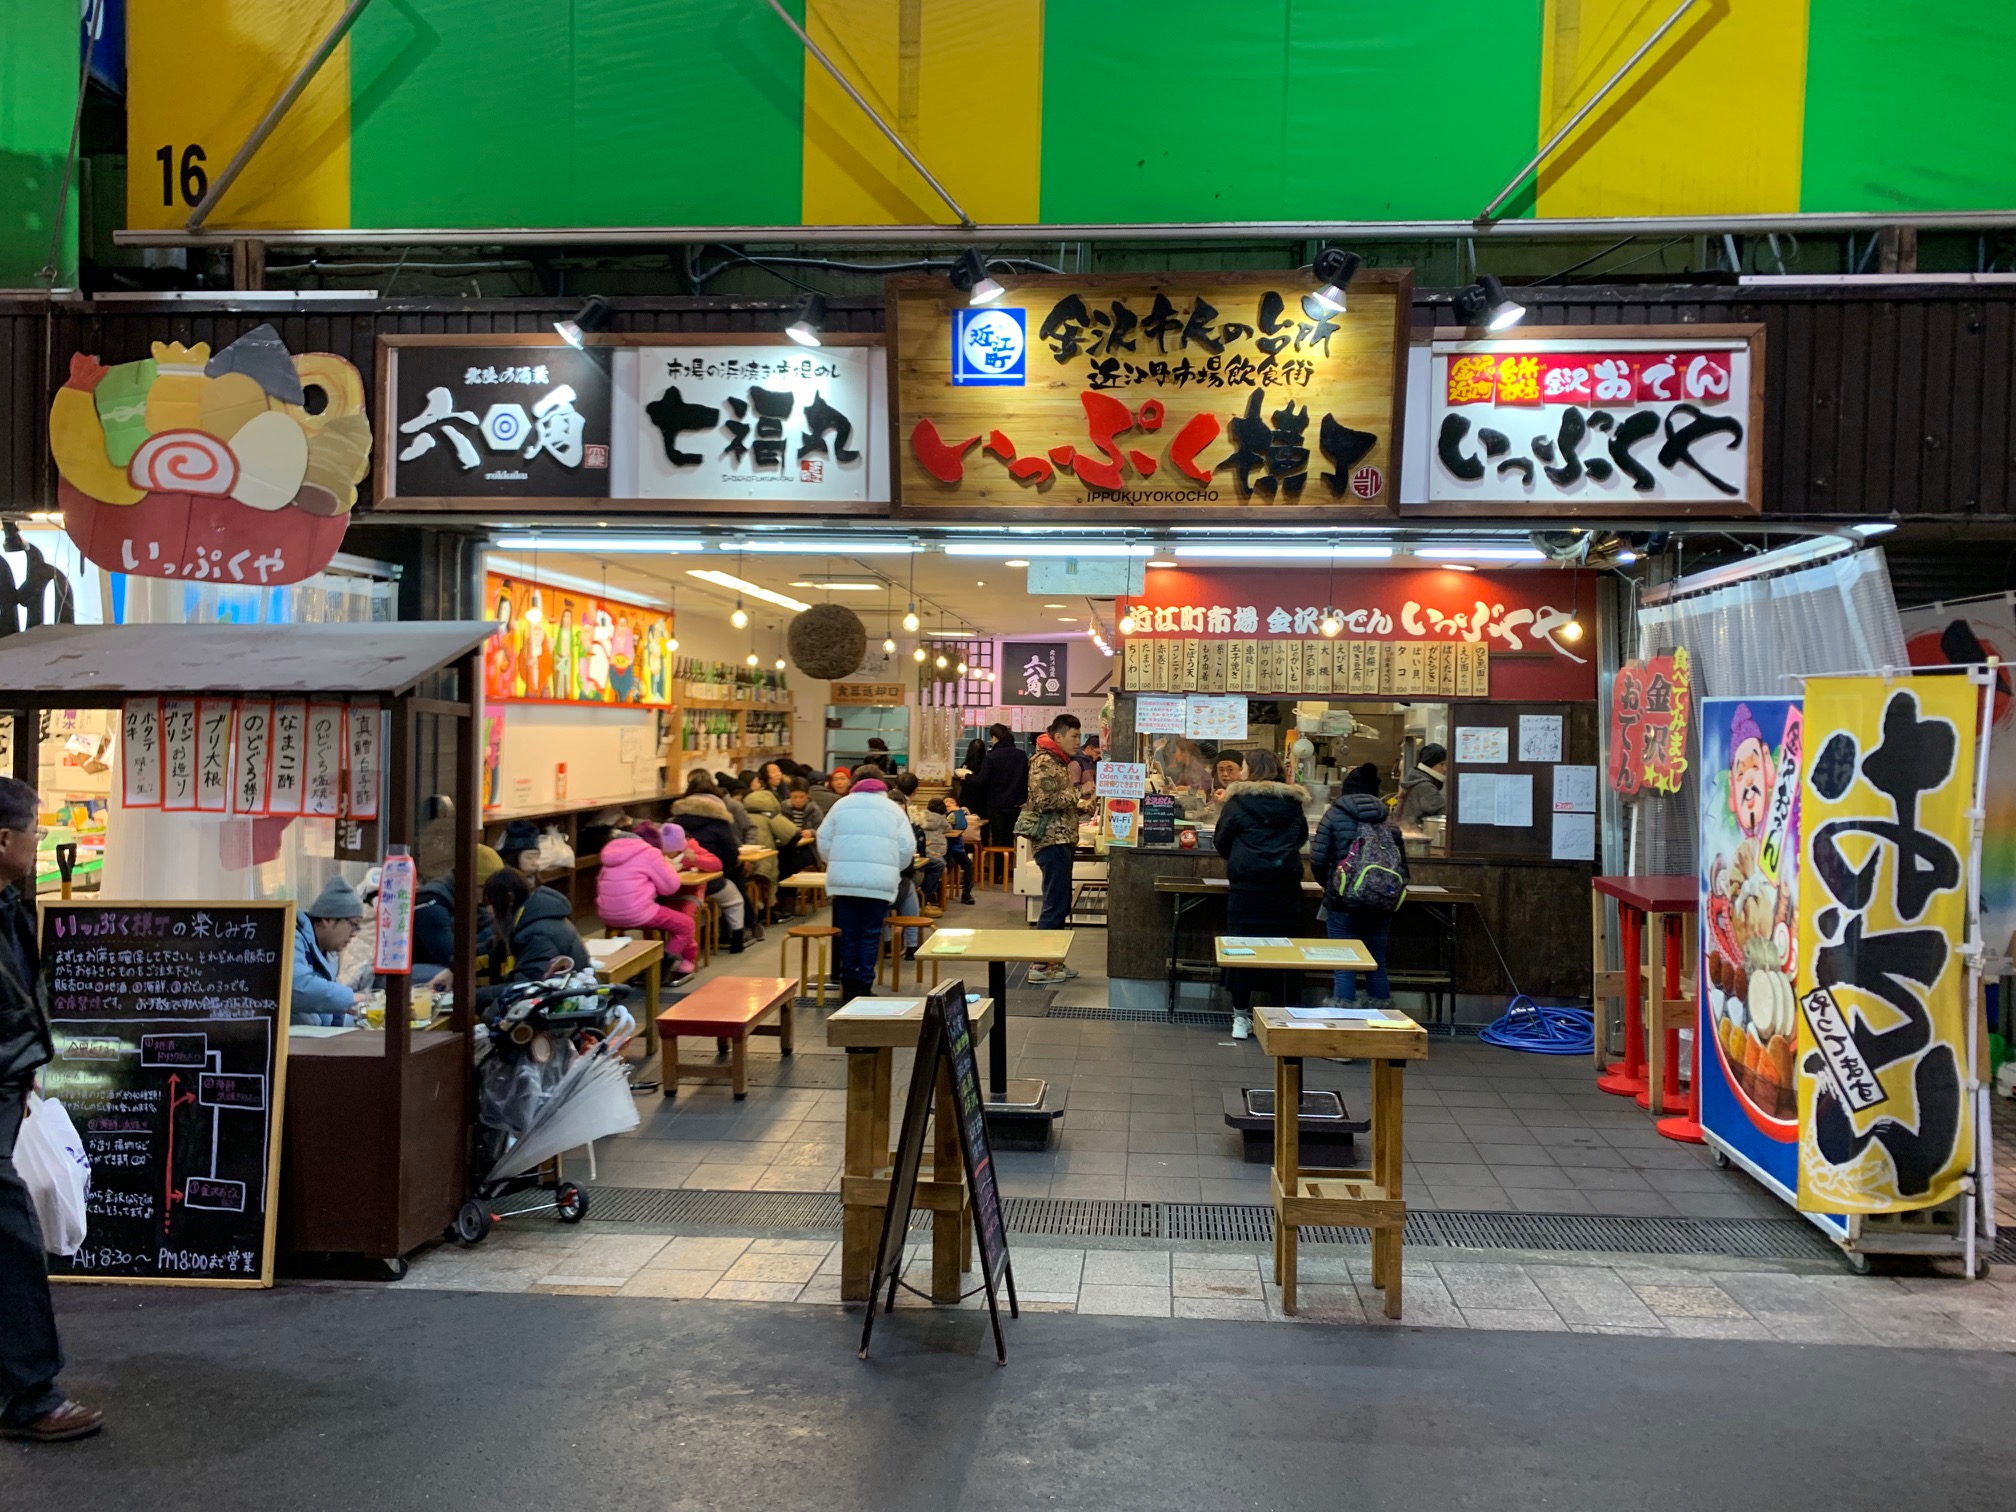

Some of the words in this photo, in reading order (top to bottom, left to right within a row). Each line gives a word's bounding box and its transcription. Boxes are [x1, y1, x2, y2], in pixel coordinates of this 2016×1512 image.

[156, 144, 207, 207] 16
[968, 324, 1015, 368] 近江町
[646, 385, 861, 476] 七福丸
[911, 388, 1378, 505] いっぷく横丁
[1438, 403, 1743, 495] いっぷくや
[1086, 490, 1219, 503] IPPUKUYOKOCHO
[121, 539, 285, 584] いっぷくや
[1128, 644, 1137, 673] ちくわ
[1142, 643, 1151, 673] たまご
[1172, 645, 1180, 680] コンニャク
[1186, 642, 1196, 678] ごぼう天
[1260, 645, 1270, 678] 竹の子
[1319, 645, 1330, 676] 大根
[1336, 644, 1346, 674] えび天
[1397, 646, 1407, 676] タコ
[126, 713, 138, 740] カキ
[141, 712, 157, 752] ホタテ
[165, 712, 178, 742] ブリ
[181, 713, 193, 742] アジ
[1617, 671, 1643, 790] おでん
[1645, 672, 1673, 764] 金沢
[1669, 646, 1690, 794] 食べてみまっし
[204, 714, 226, 789] ブリ大根
[278, 715, 298, 790] なまこ酢
[1103, 763, 1139, 773] おでん
[173, 746, 190, 797] お造り
[1108, 815, 1131, 824] Wi-Fi
[55, 911, 258, 939] いっぷく横丁の楽しみ方
